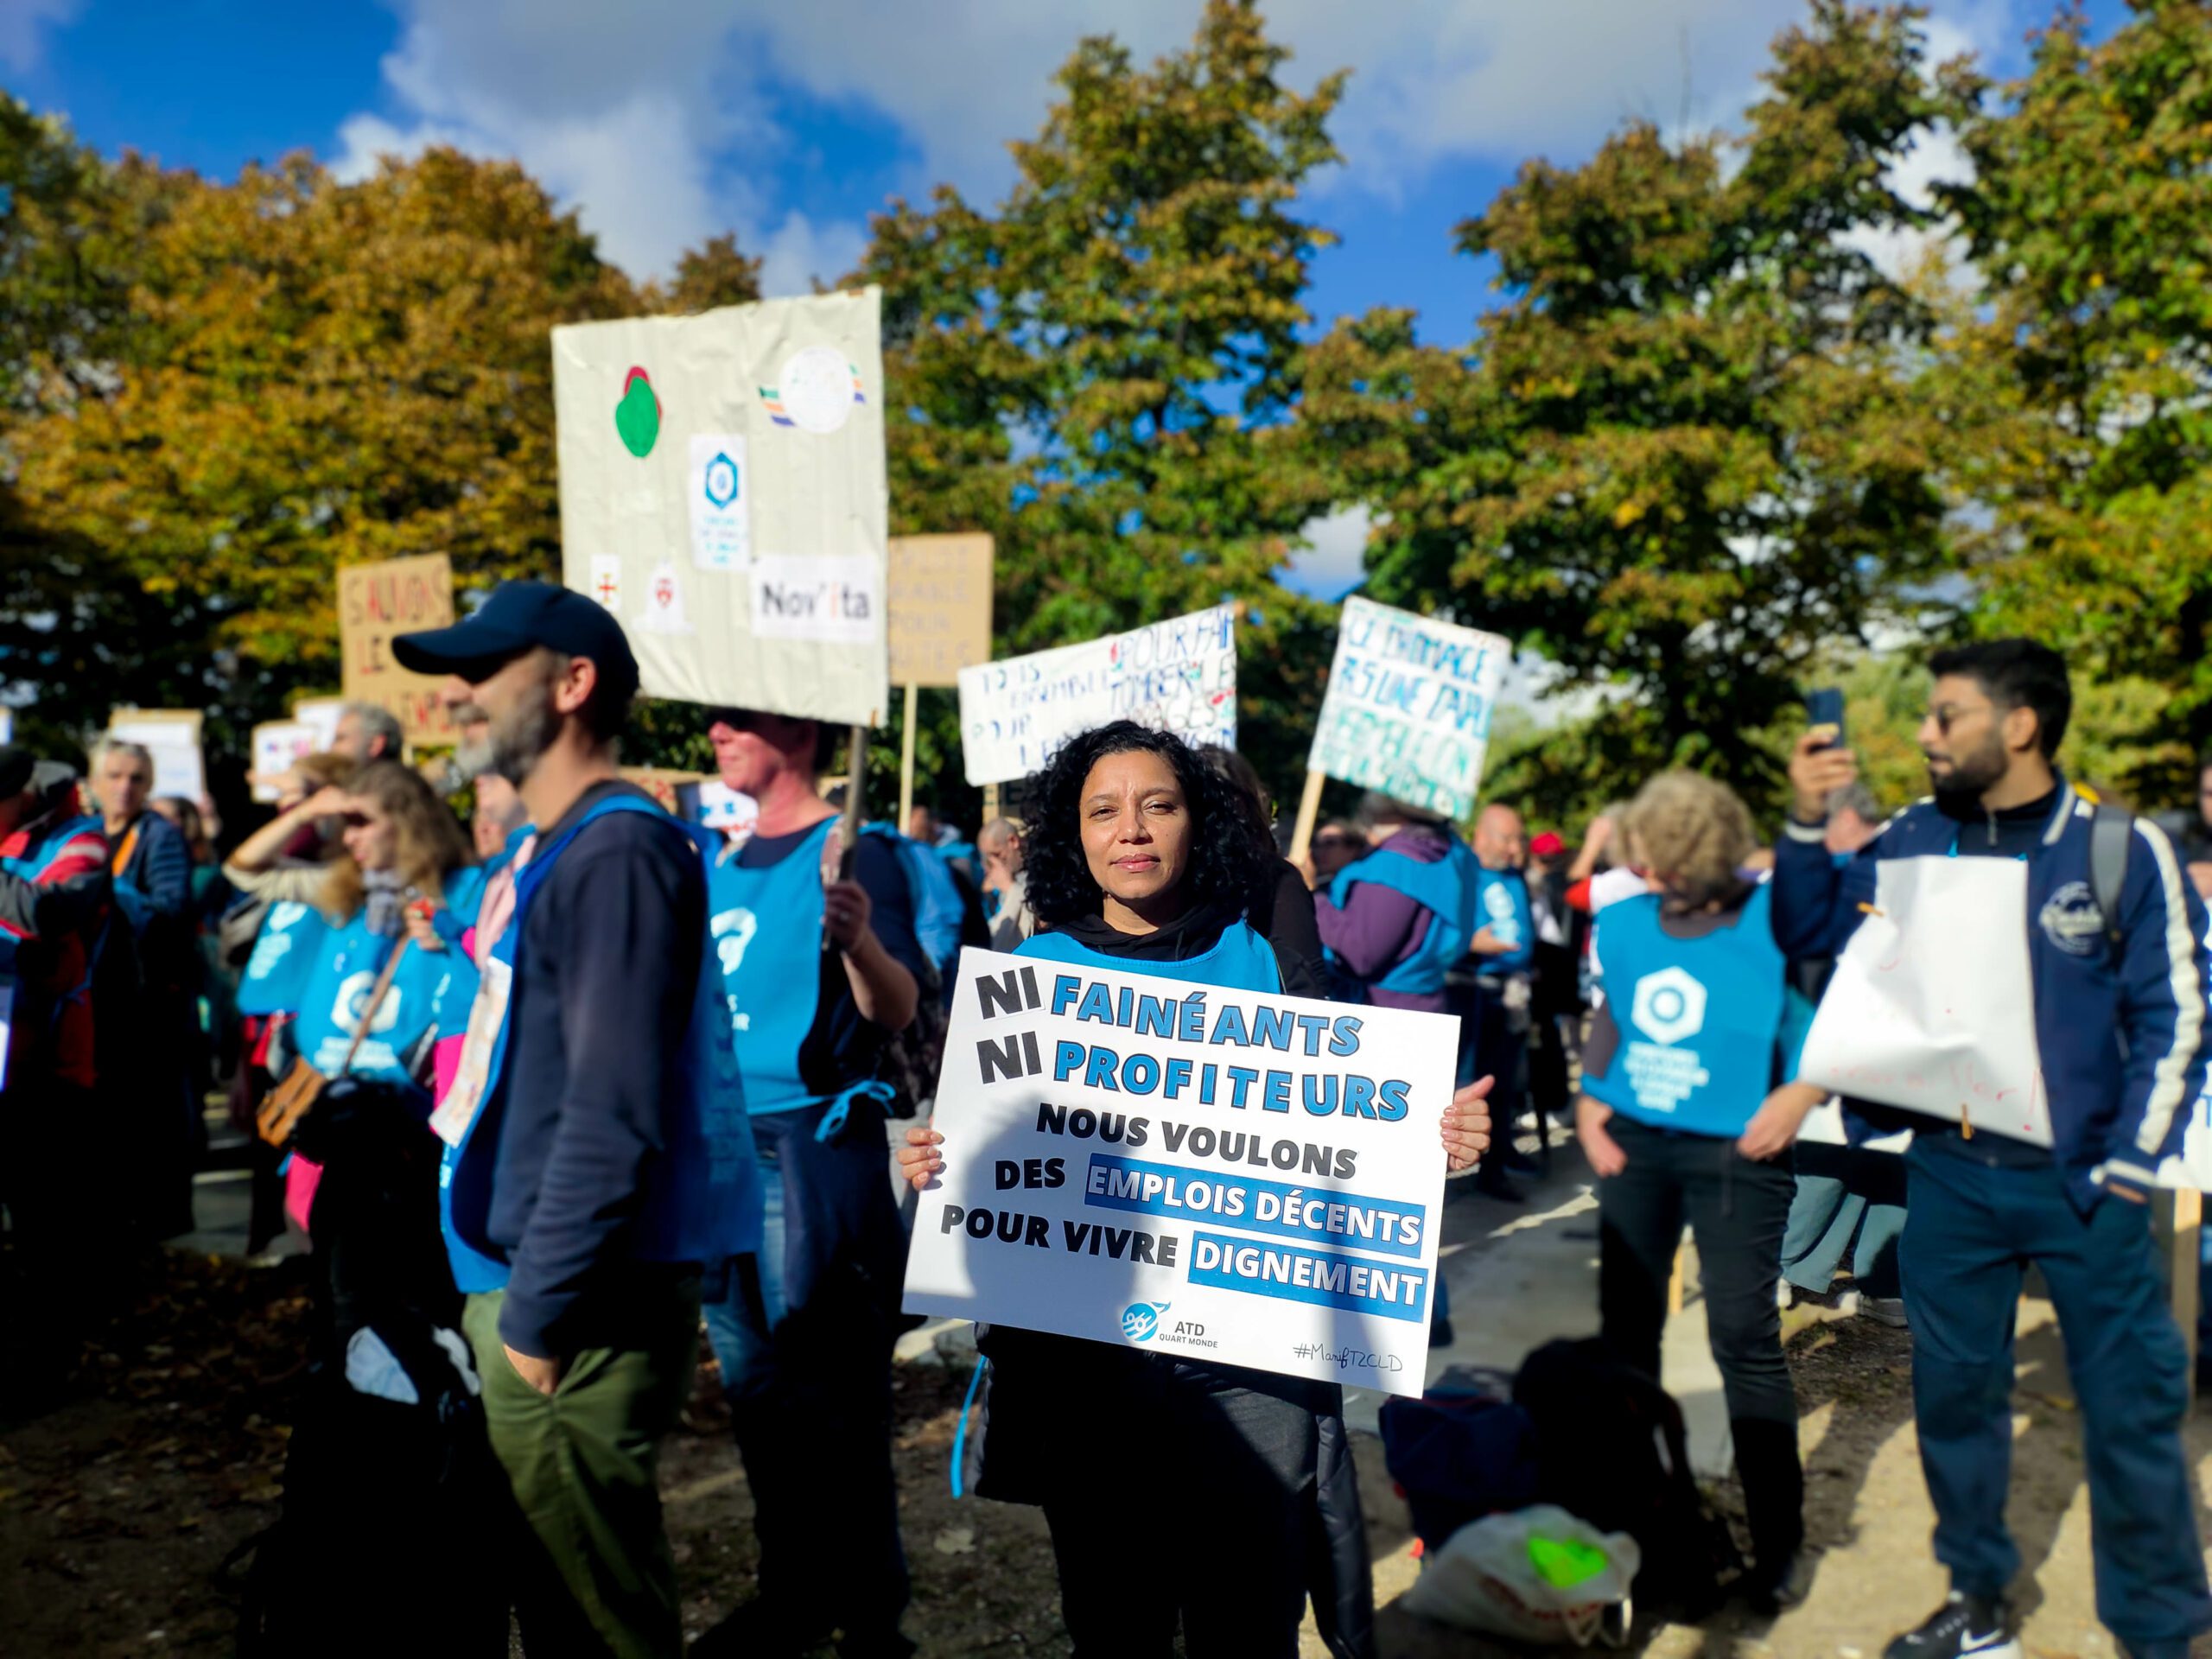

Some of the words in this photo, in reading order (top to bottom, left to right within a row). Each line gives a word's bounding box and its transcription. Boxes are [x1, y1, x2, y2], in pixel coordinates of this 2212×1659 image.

[975, 966, 1041, 1020] NI
[1051, 975, 1363, 1058] FAINÉANTS
[976, 1032, 1042, 1084] NI
[1054, 1039, 1412, 1122] PROFITEURS
[1036, 1103, 1149, 1147] NOUS
[1162, 1121, 1357, 1179] VOULONS
[995, 1158, 1065, 1191] DES
[1087, 1164, 1245, 1218] EMPLOIS
[1255, 1188, 1421, 1246] DÉCENTS
[942, 1204, 1050, 1249] POUR
[1065, 1222, 1178, 1268] VIVRE
[1195, 1241, 1423, 1306] DIGNEMENT
[1160, 1333, 1186, 1344] QUART
[1188, 1336, 1218, 1349] MONDE
[1174, 1321, 1205, 1337] ATD
